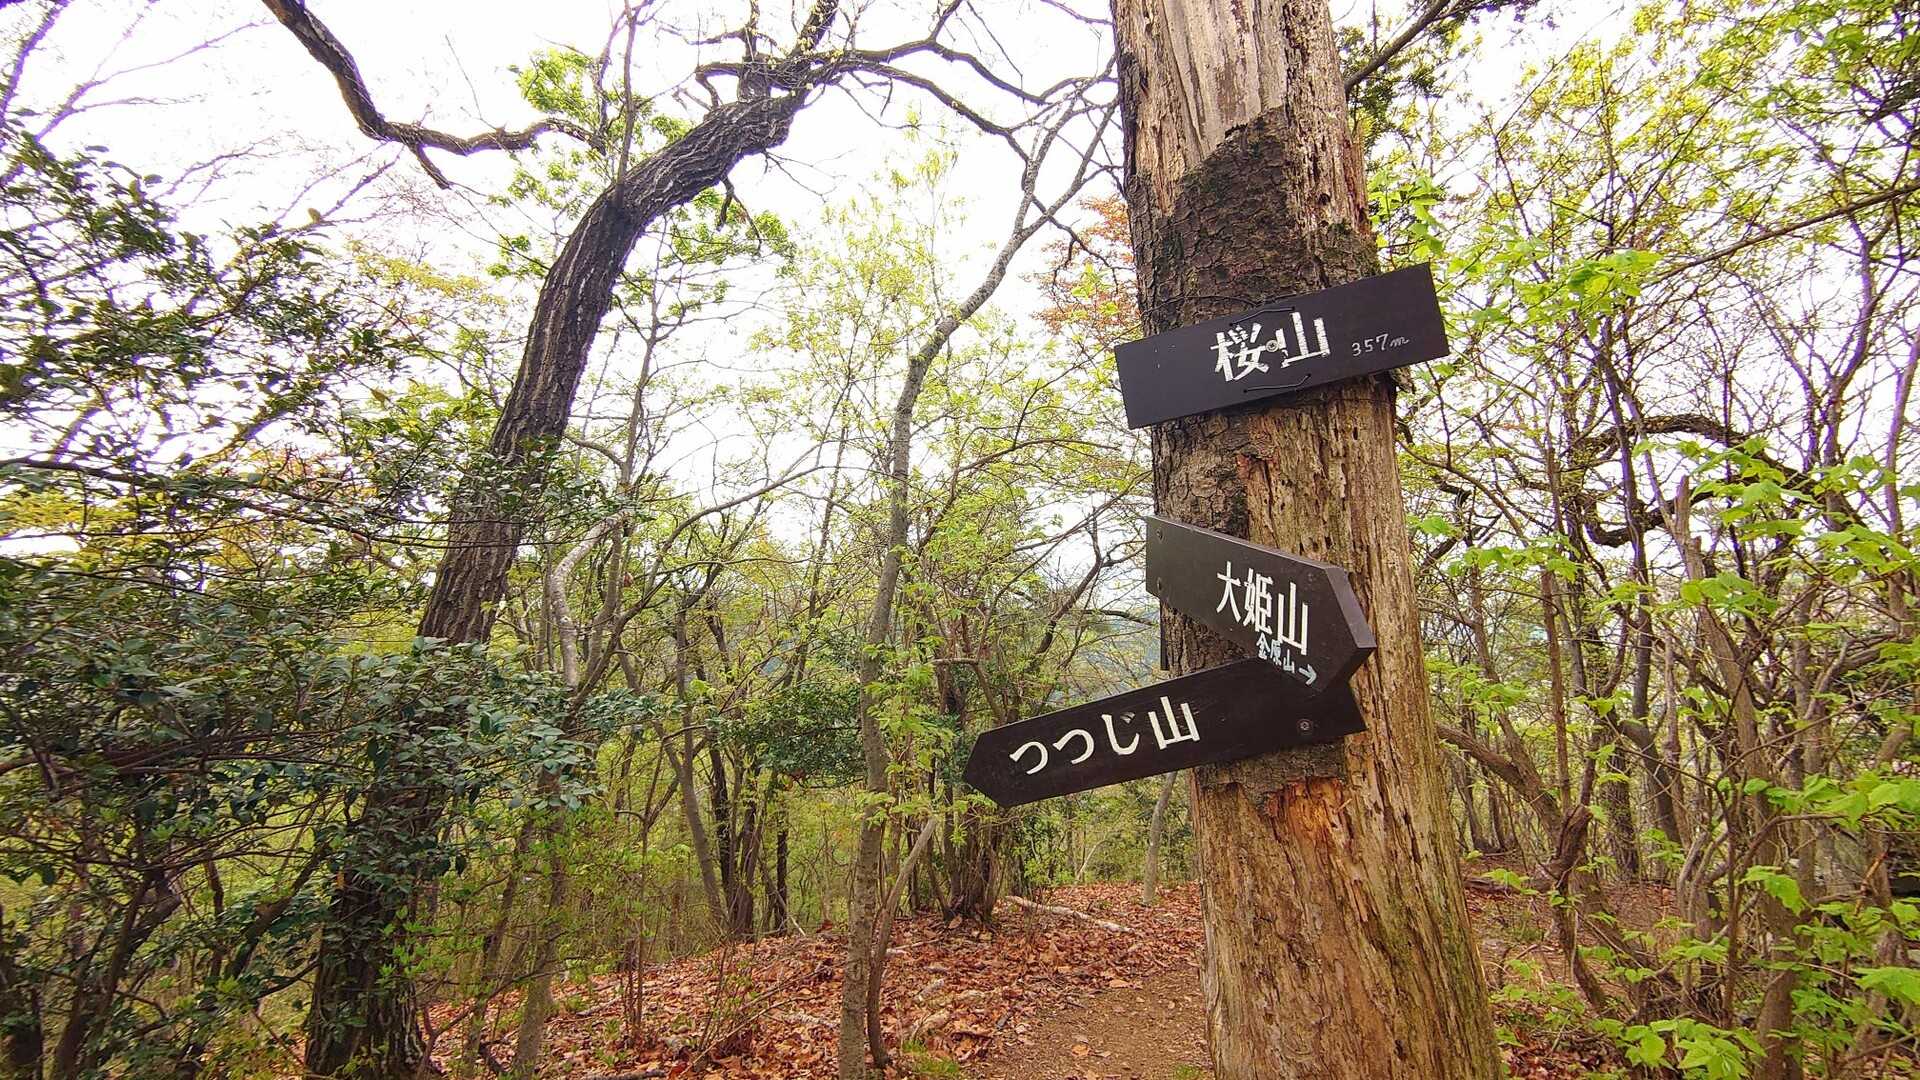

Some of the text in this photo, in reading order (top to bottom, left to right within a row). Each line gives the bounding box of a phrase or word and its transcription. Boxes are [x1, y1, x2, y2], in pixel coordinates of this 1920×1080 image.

[1210, 311, 1410, 382] 桜山 357m
[1216, 560, 1309, 656] 大姫山
[1009, 696, 1200, 775] つつじ山
